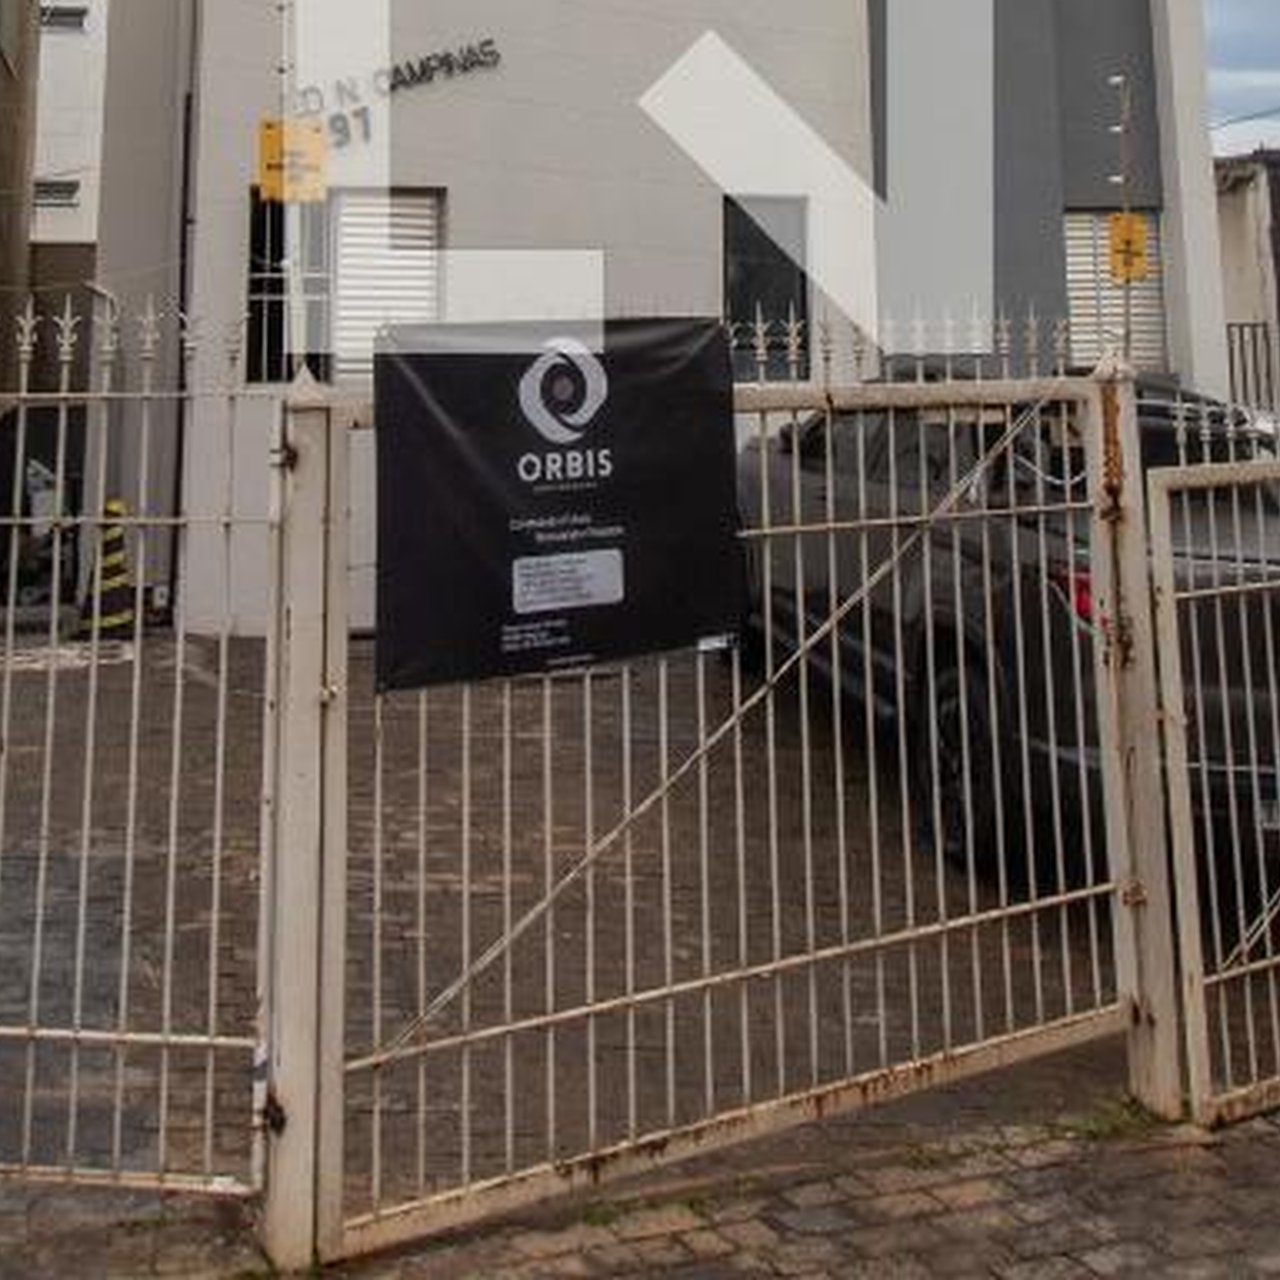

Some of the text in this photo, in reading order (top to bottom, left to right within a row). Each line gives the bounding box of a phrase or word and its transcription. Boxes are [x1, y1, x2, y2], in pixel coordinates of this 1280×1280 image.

[373, 38, 501, 98] CAMPINAS
[328, 106, 371, 148] 91
[517, 448, 613, 482] ORBIS
